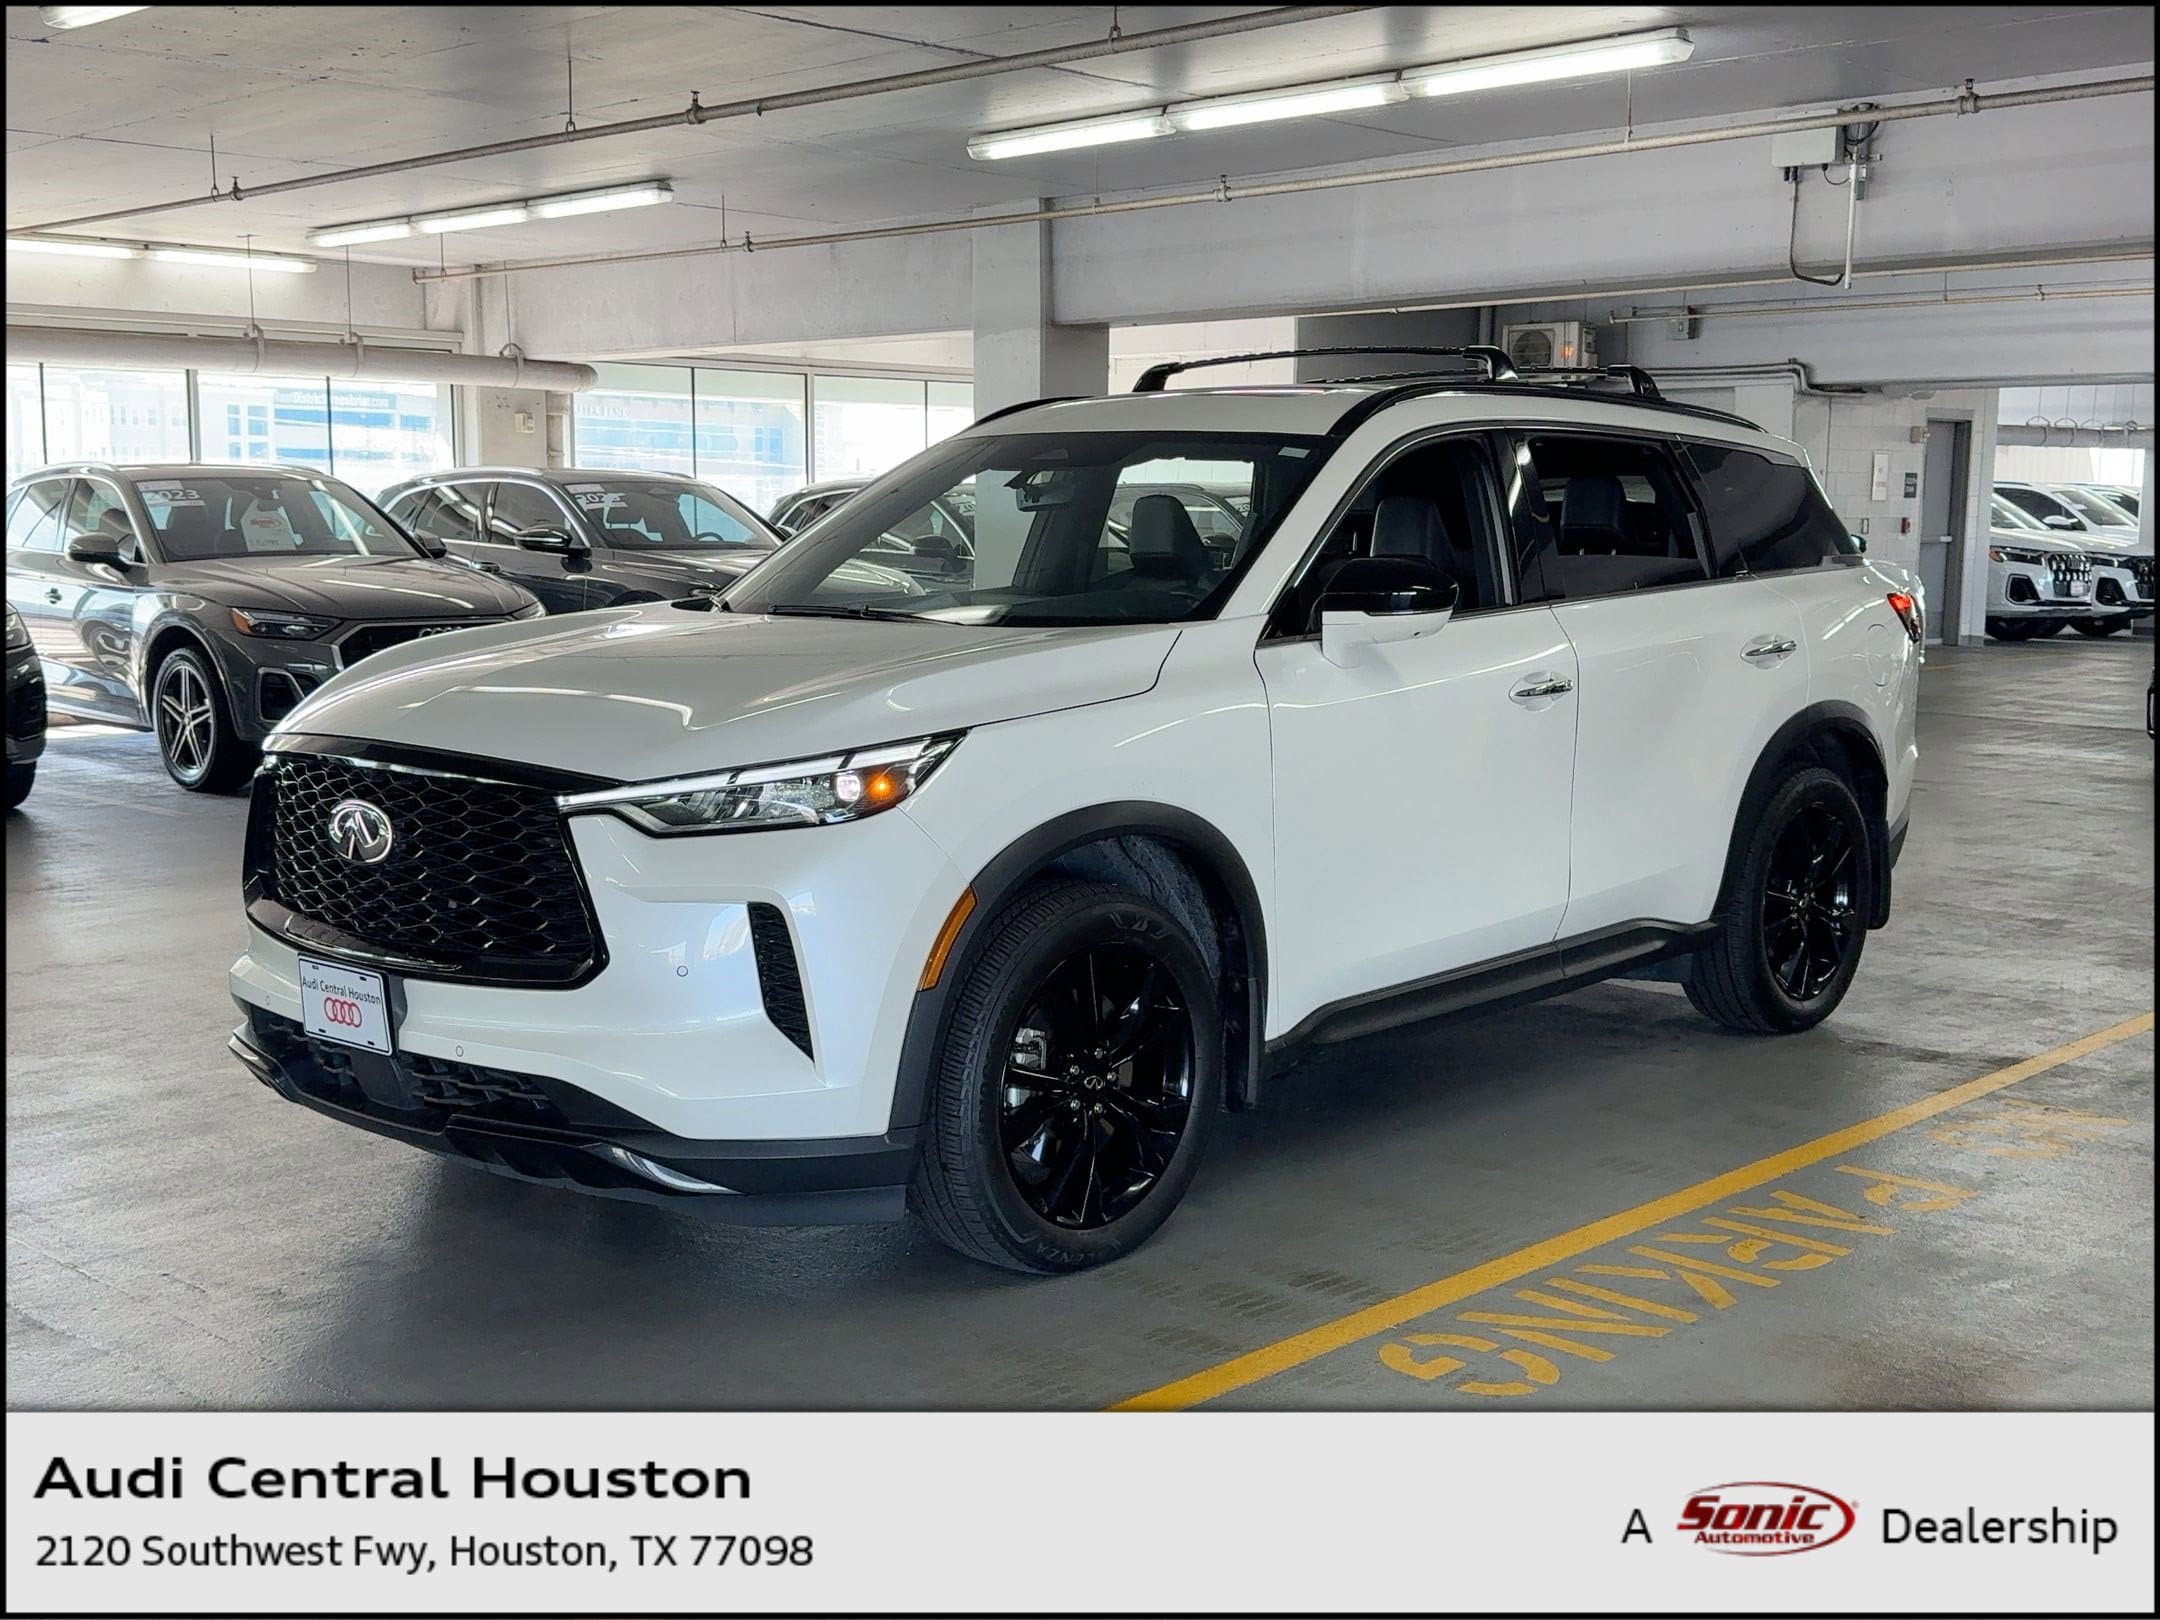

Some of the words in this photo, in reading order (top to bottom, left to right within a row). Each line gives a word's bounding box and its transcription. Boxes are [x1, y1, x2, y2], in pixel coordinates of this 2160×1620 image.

[302, 976, 319, 991] Audi
[320, 980, 347, 998] Central
[347, 987, 382, 1006] Houston
[1377, 1163, 1980, 1397] PARKING
